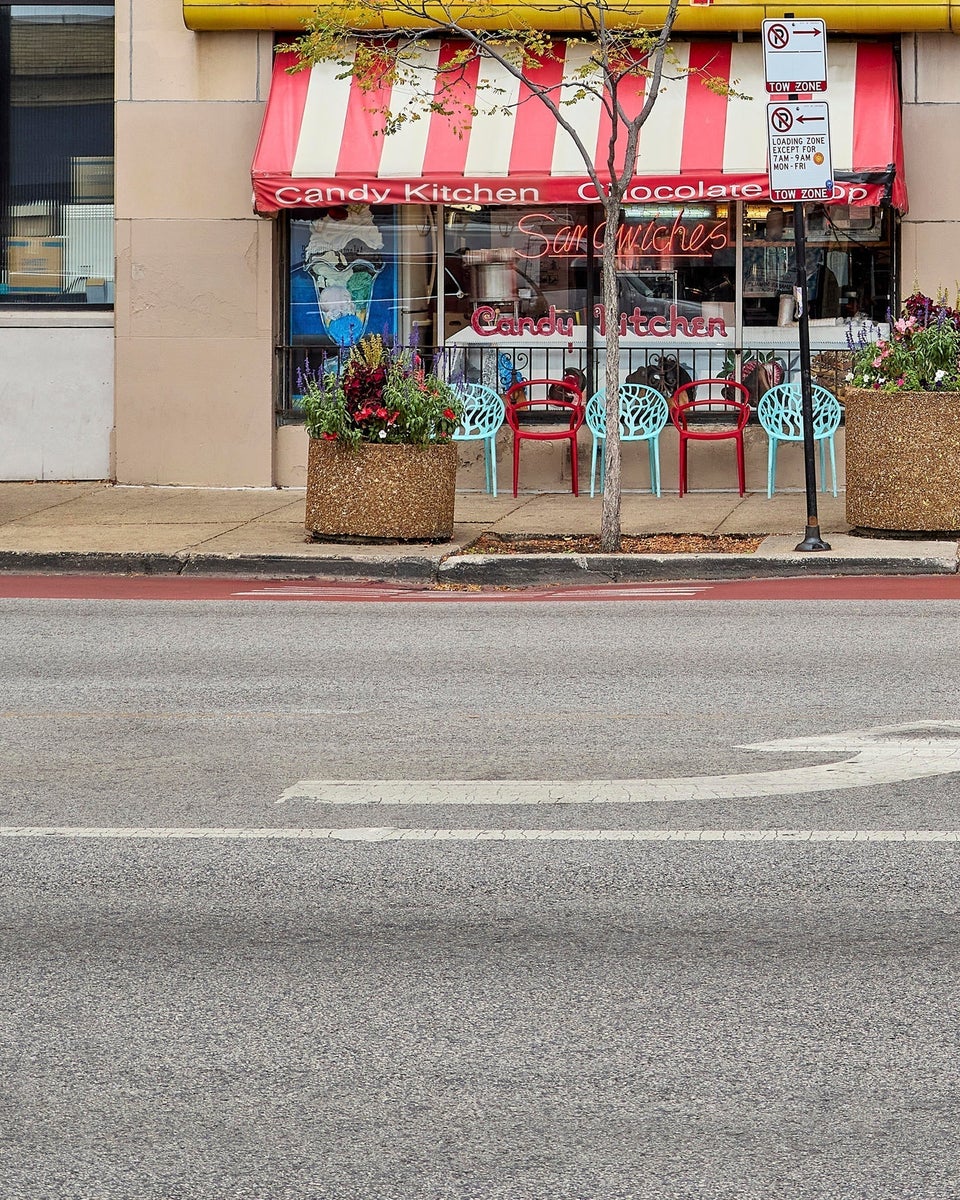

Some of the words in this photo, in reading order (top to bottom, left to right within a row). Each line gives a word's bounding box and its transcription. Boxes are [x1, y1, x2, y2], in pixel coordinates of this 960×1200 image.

[769, 82, 790, 92] TOW
[795, 81, 822, 92] ZONE
[772, 137, 803, 146] LOADING
[806, 136, 825, 145] ZONE
[772, 145, 799, 154] EXCEPT
[802, 145, 817, 153] FOR
[274, 183, 391, 205] Candy
[404, 182, 540, 202] Kitchen
[775, 189, 797, 200] TOW
[801, 188, 828, 199] ZONE
[470, 305, 574, 353] Candy
